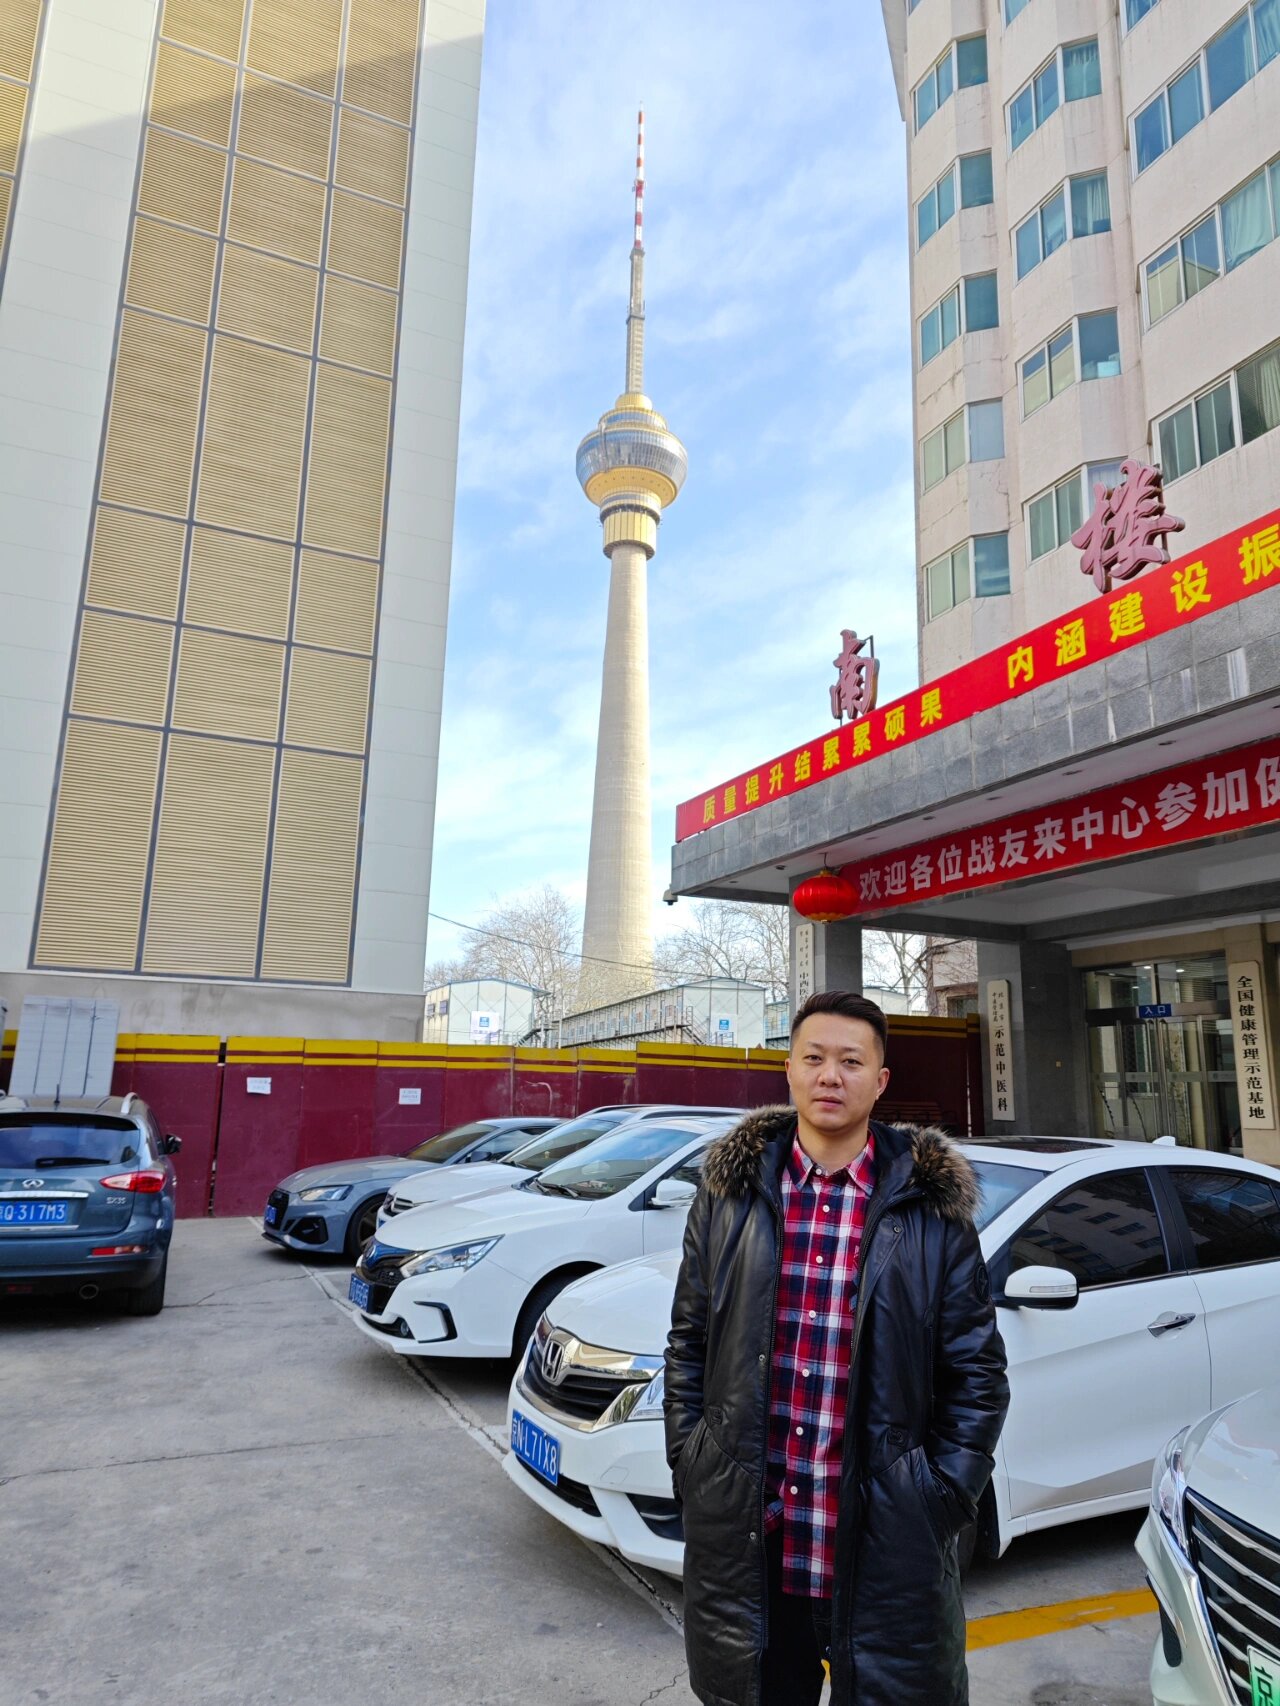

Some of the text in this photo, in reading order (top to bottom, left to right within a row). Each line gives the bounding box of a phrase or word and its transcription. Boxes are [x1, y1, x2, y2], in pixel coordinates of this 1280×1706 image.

[703, 688, 942, 824] 质量提升结累累硕果
[1144, 1005, 1166, 1015] 入口
[1236, 975, 1266, 1119] 全国健康管理示范基地
[994, 1025, 1008, 1112] 示范中医科
[0, 1203, 66, 1221] Q·317M3
